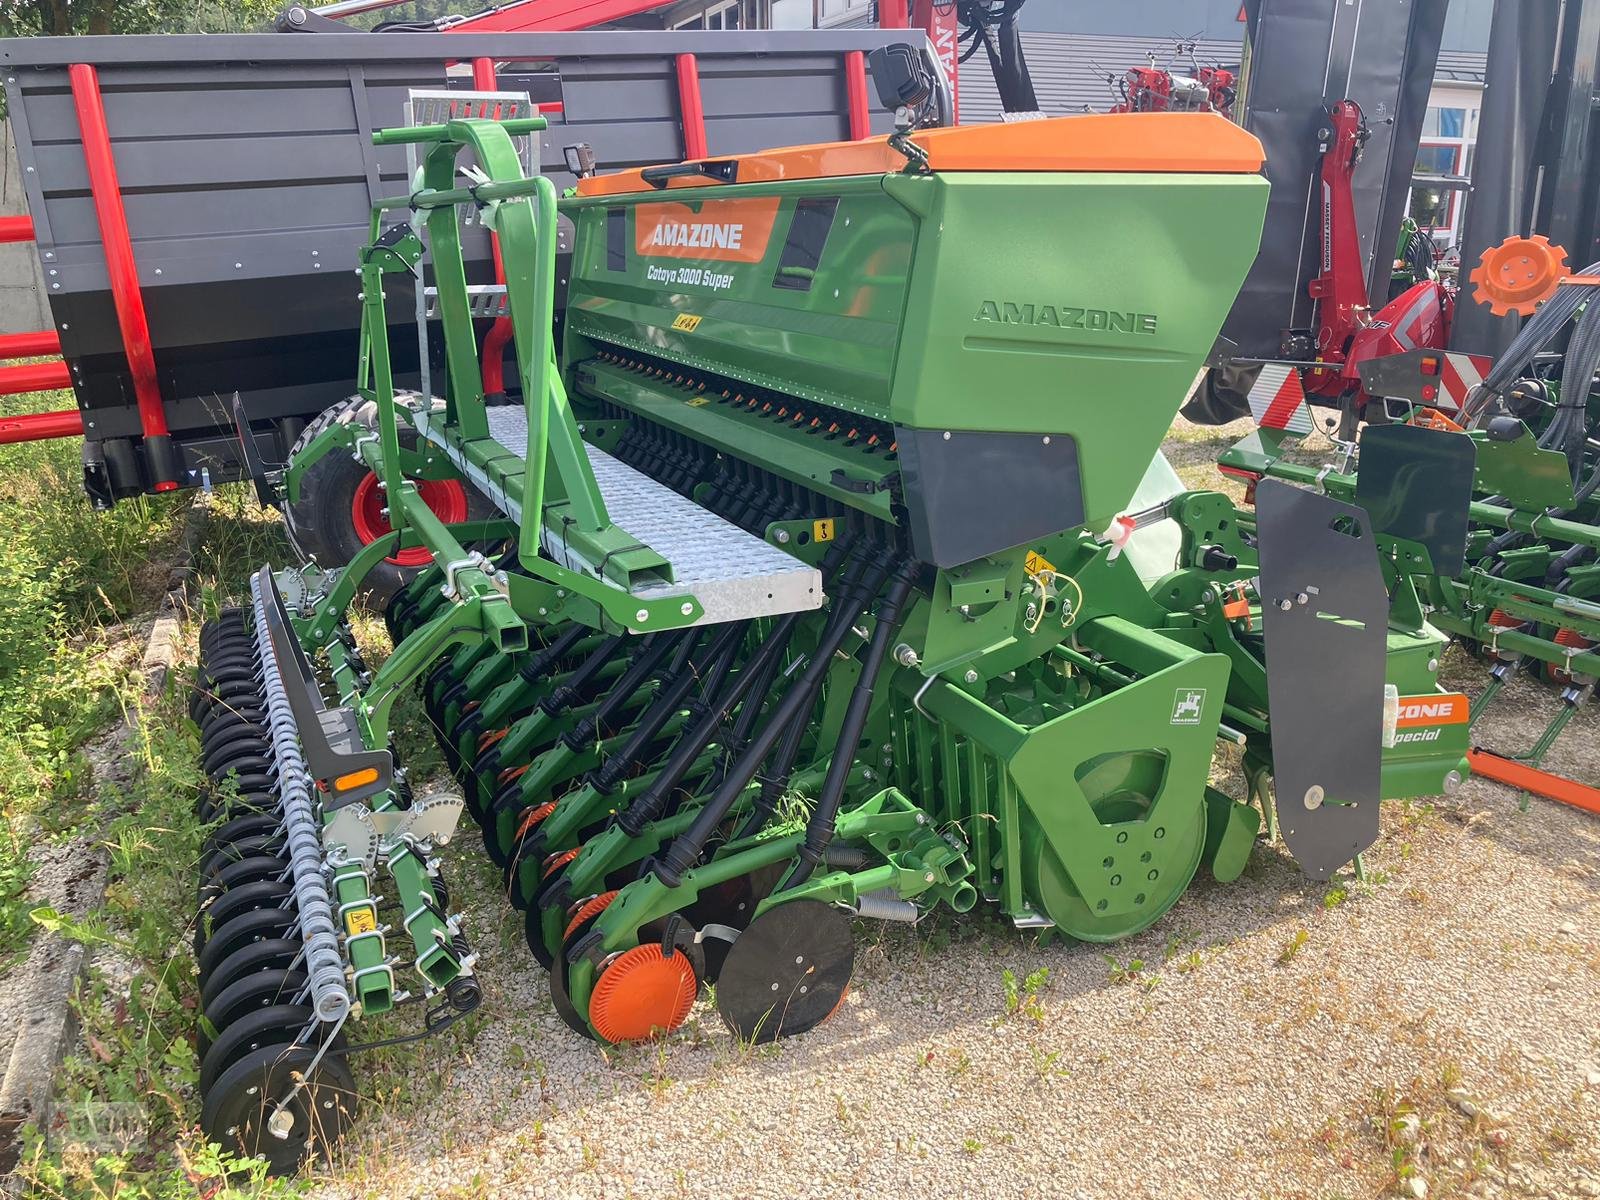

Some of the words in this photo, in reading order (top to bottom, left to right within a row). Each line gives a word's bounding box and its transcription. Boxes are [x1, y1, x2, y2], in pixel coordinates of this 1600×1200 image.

[652, 223, 743, 250] AMAZONE
[647, 265, 677, 286] Cataya
[677, 267, 702, 286] 3000
[702, 269, 734, 291] Super
[973, 300, 1158, 335] AMAZONE
[1397, 703, 1453, 719] ZONE
[1394, 729, 1441, 744] pecial
